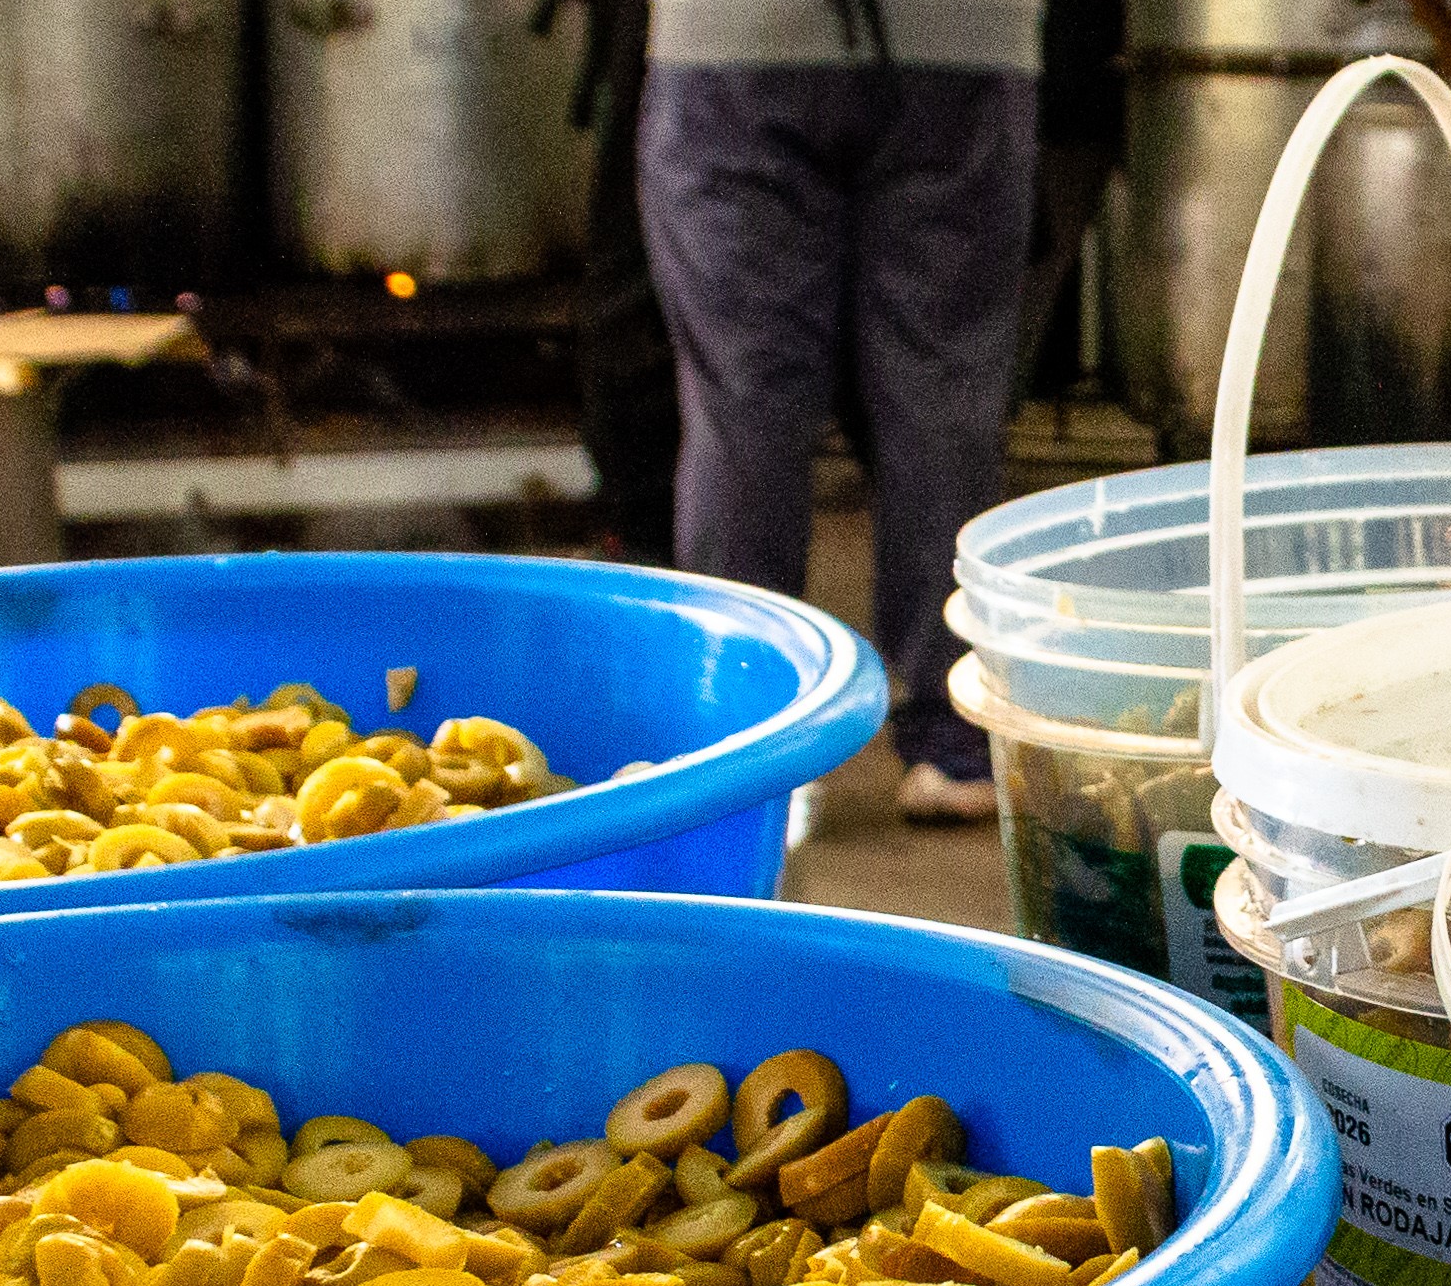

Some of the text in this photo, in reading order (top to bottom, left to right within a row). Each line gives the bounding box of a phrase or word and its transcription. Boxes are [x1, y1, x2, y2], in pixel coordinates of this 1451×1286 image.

[1322, 1078, 1370, 1114] COSECHA
[1361, 1167, 1412, 1202] Verdes
[1417, 1192, 1438, 1210] en
